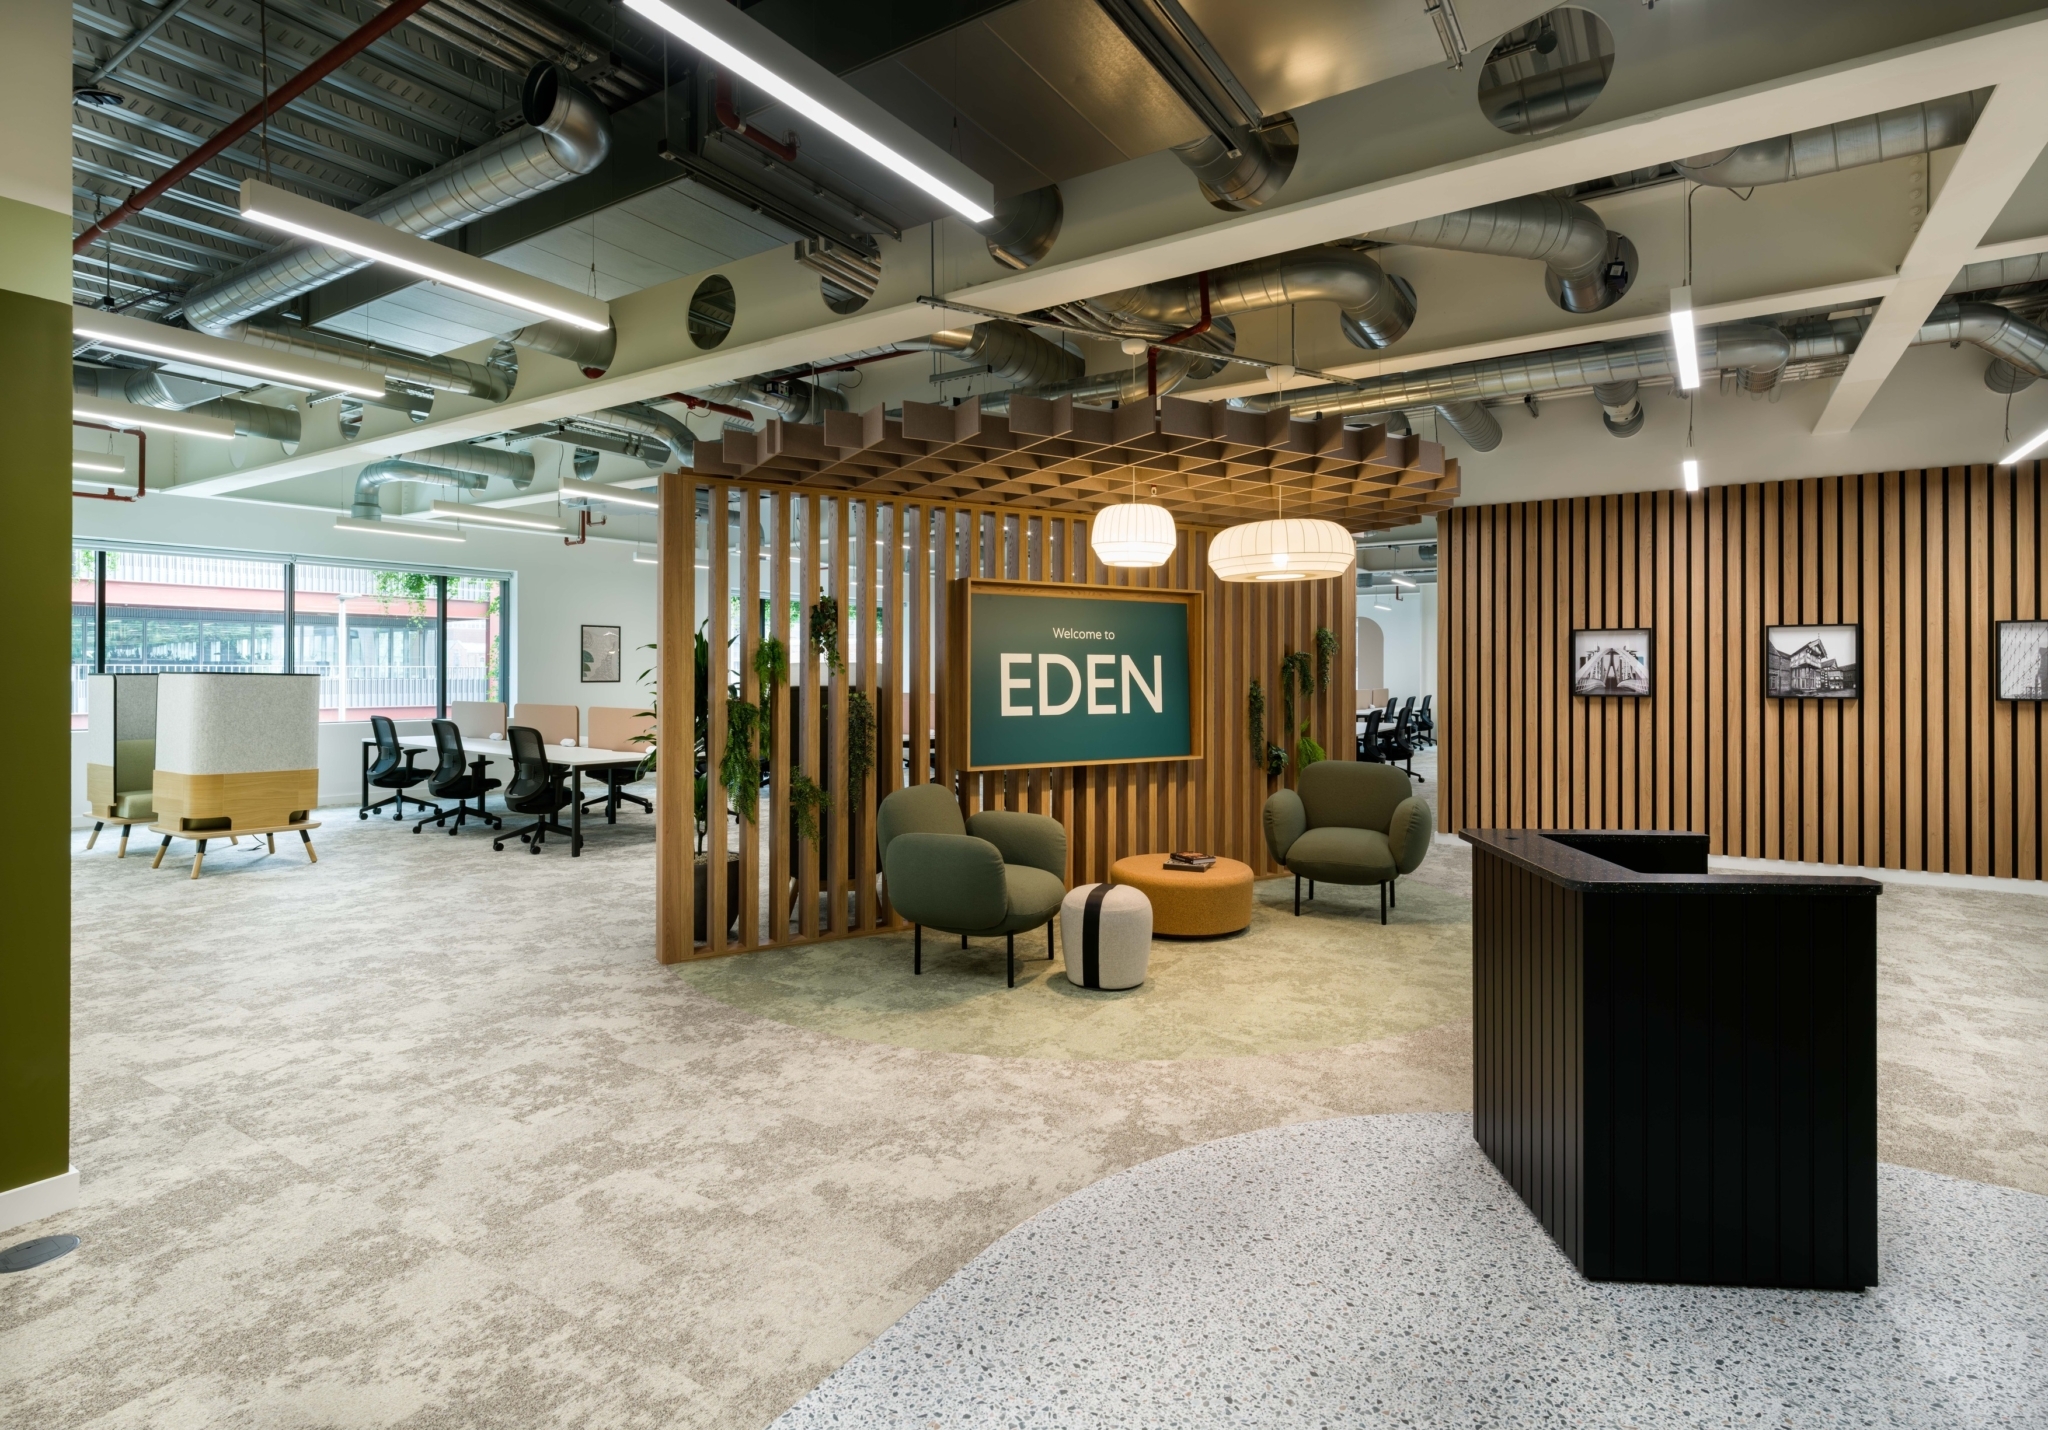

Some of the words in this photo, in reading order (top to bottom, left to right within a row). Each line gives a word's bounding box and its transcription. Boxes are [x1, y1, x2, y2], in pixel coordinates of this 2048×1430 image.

[1053, 627, 1102, 640] Welcome
[1104, 631, 1115, 640] to
[1000, 653, 1163, 717] EDEN
